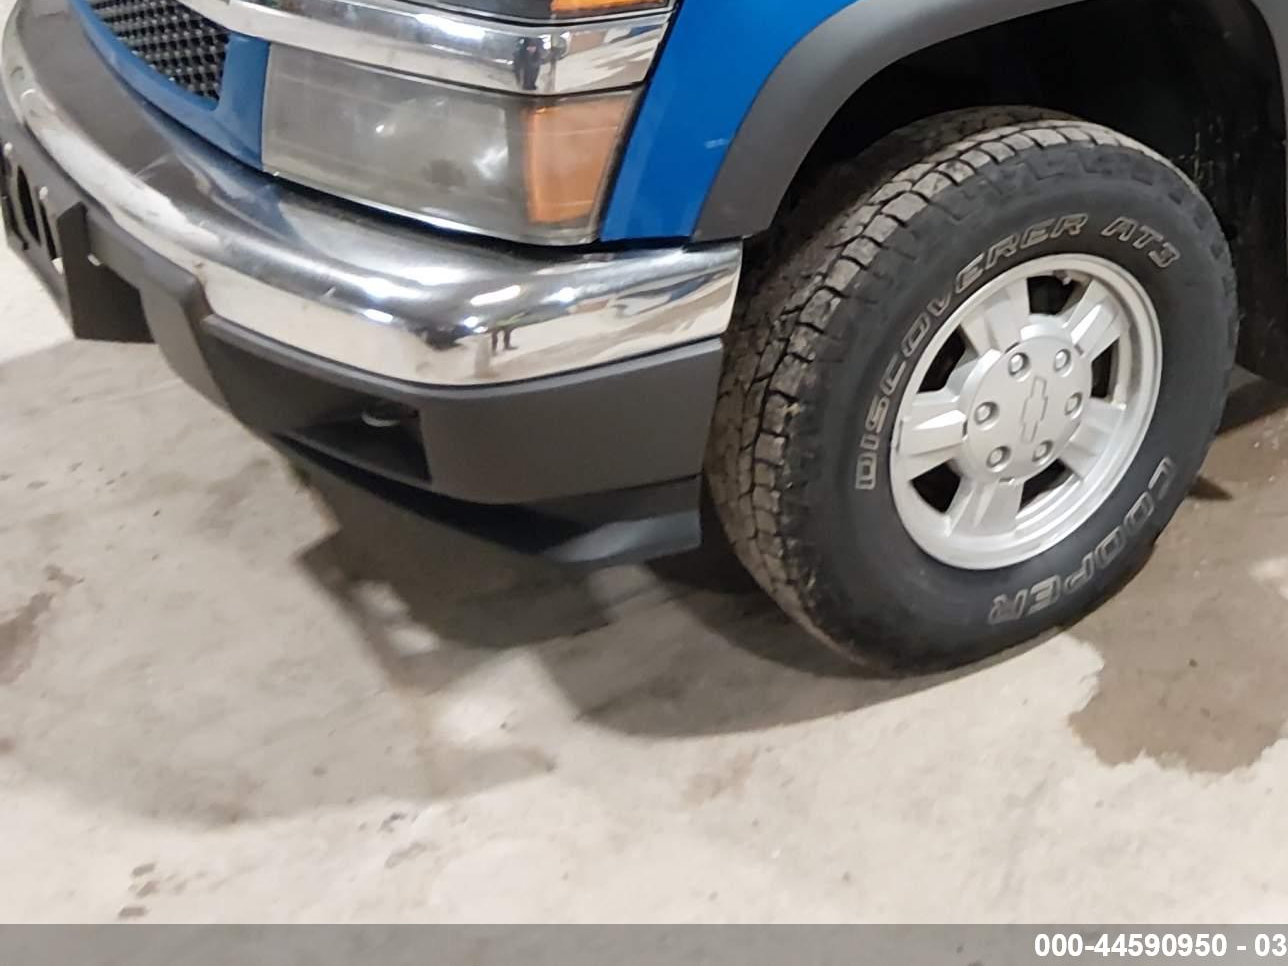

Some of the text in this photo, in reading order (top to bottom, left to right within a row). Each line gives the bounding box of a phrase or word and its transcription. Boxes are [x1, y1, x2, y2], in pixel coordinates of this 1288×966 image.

[856, 212, 1181, 491] DISCOVERER AT3
[988, 456, 1177, 625] COOPER
